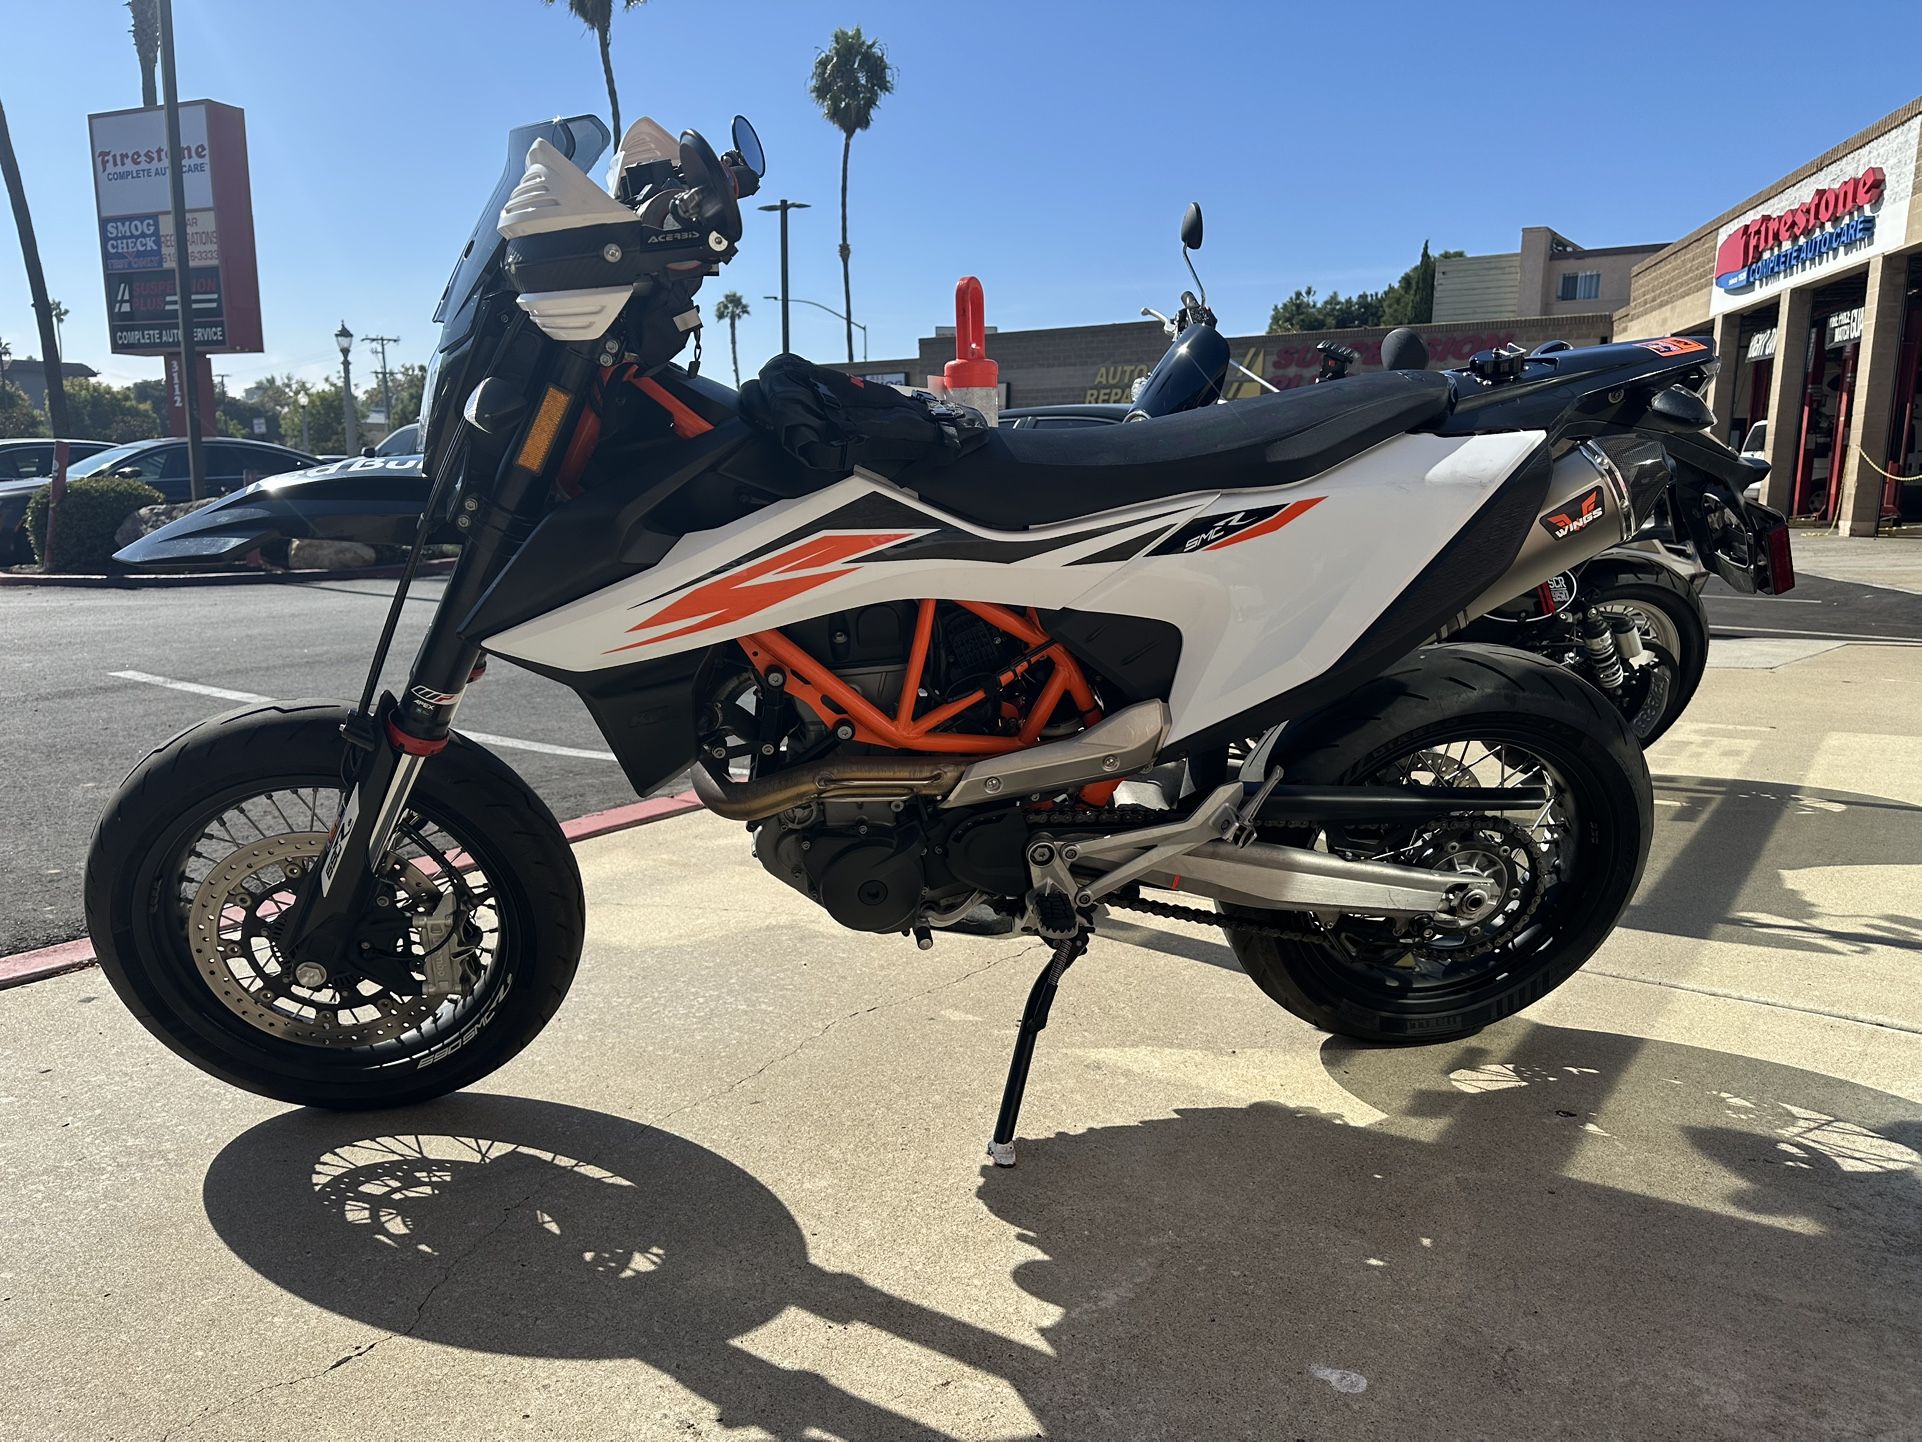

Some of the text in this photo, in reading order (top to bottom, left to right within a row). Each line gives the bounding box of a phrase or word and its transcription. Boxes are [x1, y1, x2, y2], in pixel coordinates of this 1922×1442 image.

[98, 143, 207, 173] Firestne
[107, 168, 152, 181] COMPLETE
[1742, 167, 1884, 266] Firestone
[107, 219, 155, 238] SMOG
[648, 231, 700, 244] ACERBIS
[107, 236, 158, 253] CHECK
[1750, 246, 1799, 282] COMPLETE
[1800, 232, 1831, 263] AUTO
[1831, 217, 1872, 249] CARE
[117, 331, 160, 344] COMPLETE
[193, 327, 223, 341] ERVICE
[171, 360, 182, 407] 3112
[1554, 506, 1603, 538] WINGS
[1547, 576, 1567, 589] SCR
[413, 699, 436, 710] APEX
